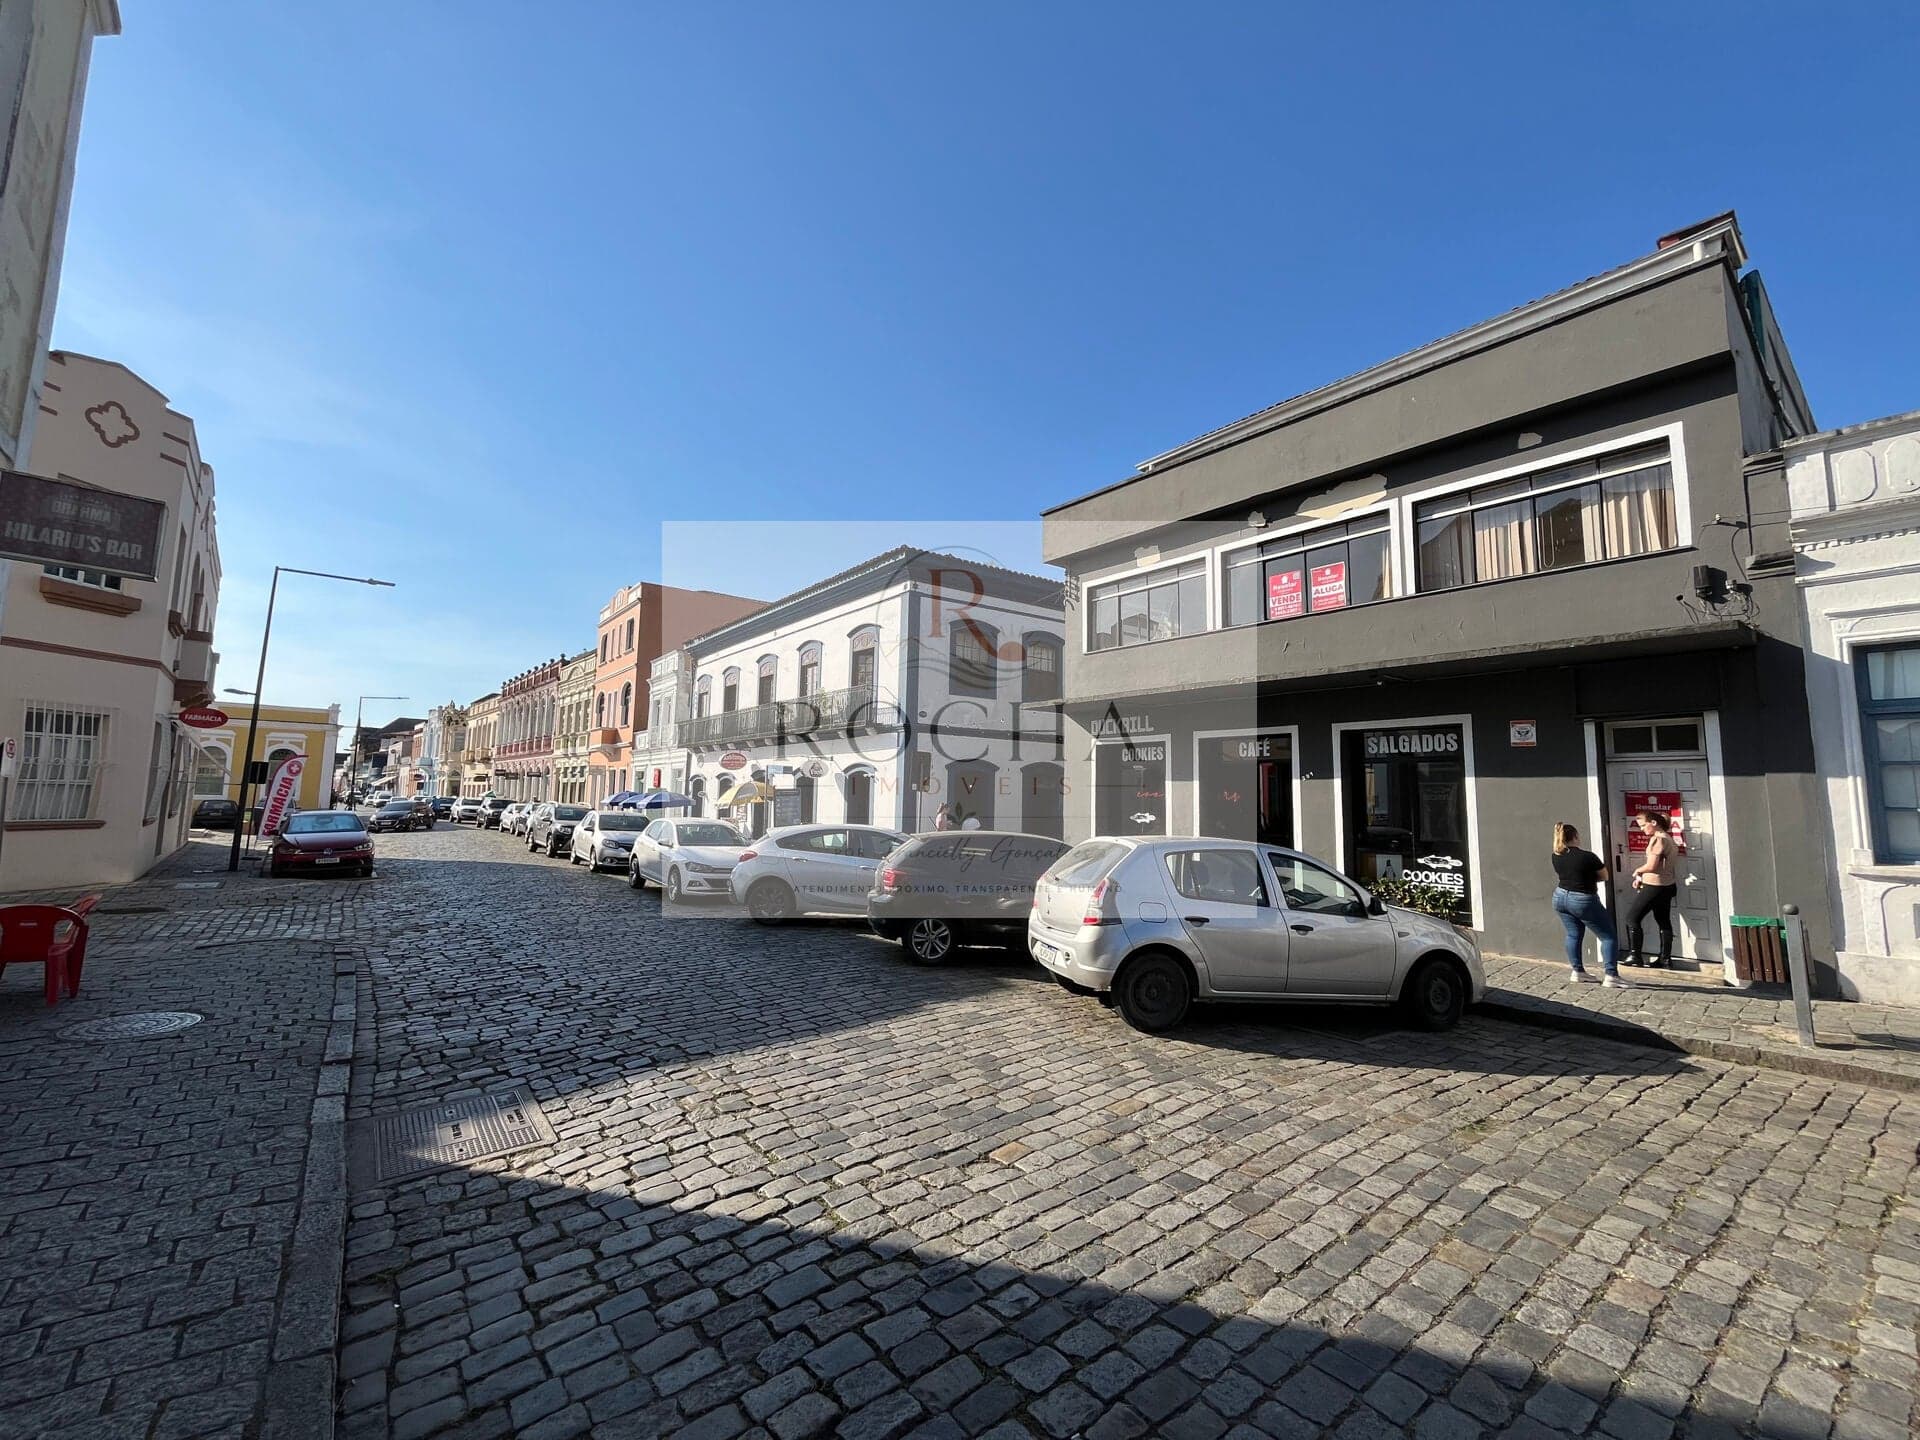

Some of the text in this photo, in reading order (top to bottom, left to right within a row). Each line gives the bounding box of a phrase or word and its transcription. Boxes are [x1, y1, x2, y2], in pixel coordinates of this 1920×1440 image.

[106, 539, 143, 560] BAR
[1313, 583, 1344, 596] ALUGA
[1271, 593, 1301, 606] VENDE
[1238, 738, 1271, 758] CAFÉ
[1367, 733, 1458, 754] SALGADOS
[1121, 746, 1164, 761] COOKIES
[262, 776, 295, 837] FARMÁCIA
[1402, 869, 1464, 886] COOKIES
